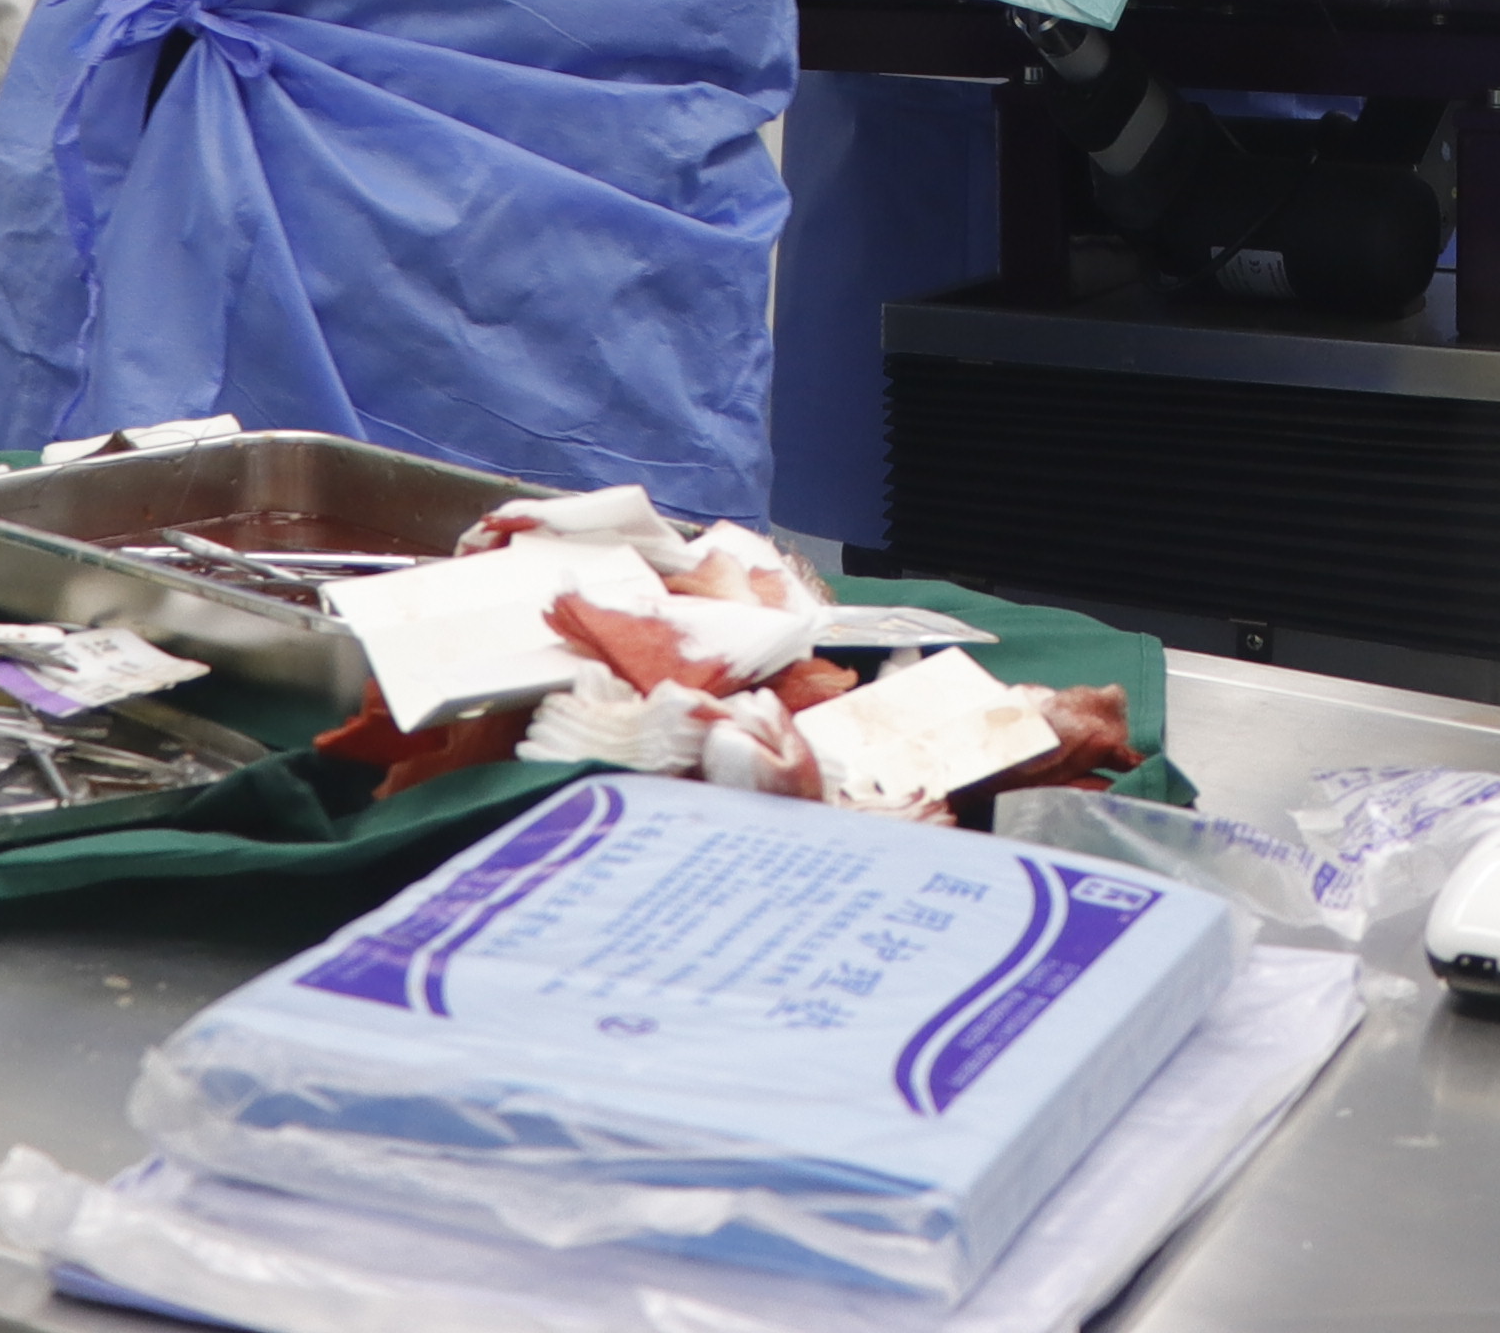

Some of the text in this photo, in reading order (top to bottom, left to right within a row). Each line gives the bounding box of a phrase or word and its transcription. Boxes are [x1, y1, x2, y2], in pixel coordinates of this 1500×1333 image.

[763, 871, 991, 1030] 医用护理垫
